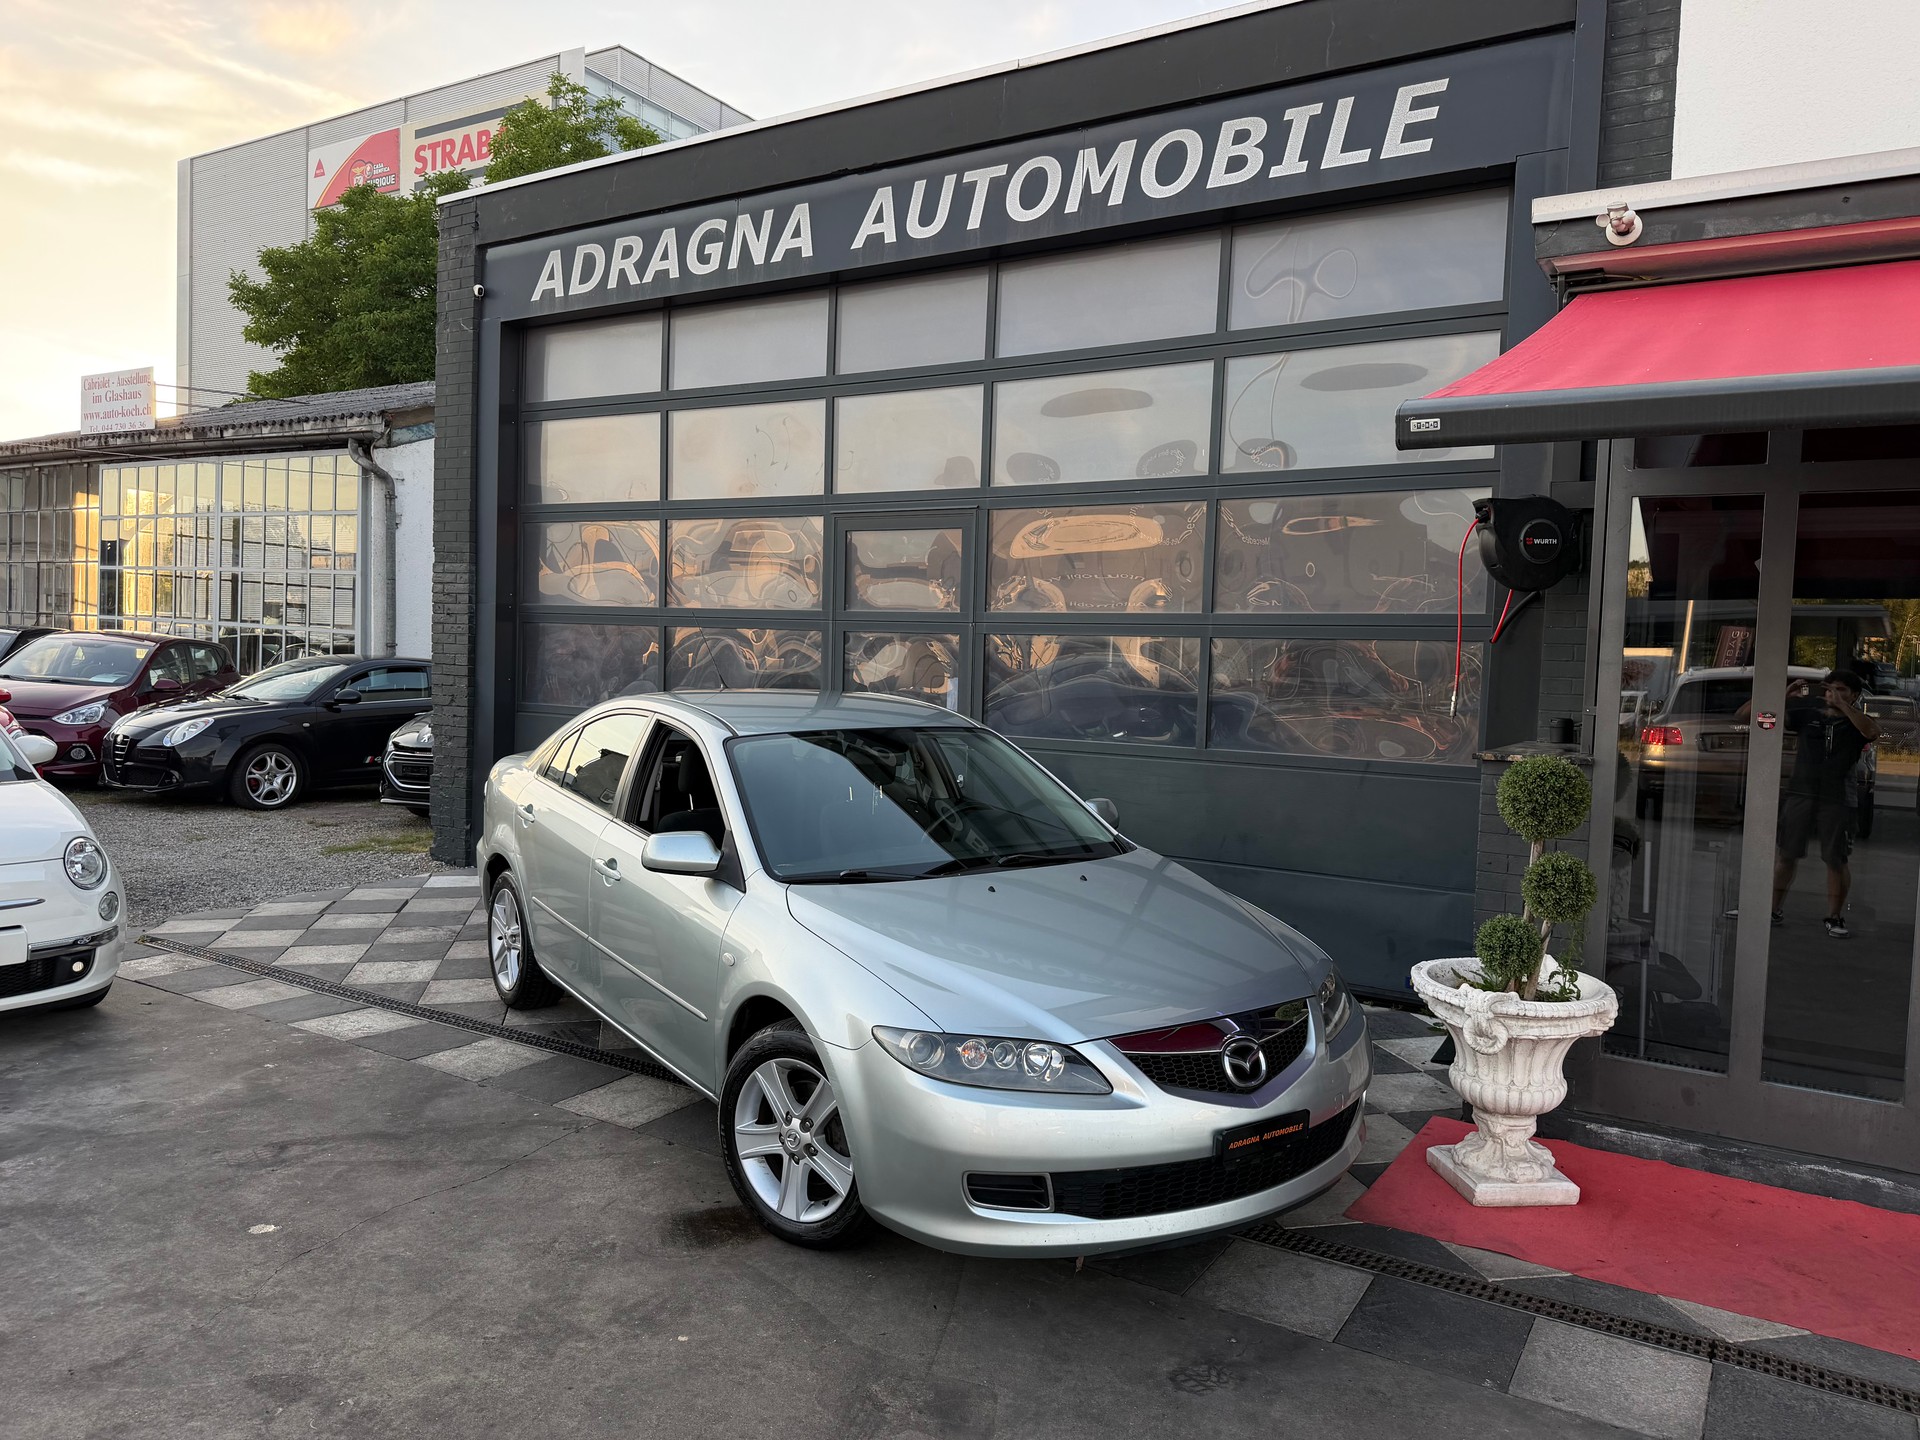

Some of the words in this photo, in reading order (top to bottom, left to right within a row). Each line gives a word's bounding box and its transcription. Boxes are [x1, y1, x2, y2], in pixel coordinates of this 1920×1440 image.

[413, 126, 508, 176] STRAB
[529, 202, 815, 302] ADRAGNA
[849, 77, 1450, 250] AUTOMOBILE
[83, 376, 110, 391] Cabriolet
[116, 372, 152, 387] Ausstellung
[92, 392, 102, 404] im
[104, 388, 142, 403] Glashaus
[83, 403, 152, 422] www.auto-koch.ch
[101, 424, 113, 432] 044
[1228, 1134, 1261, 1150] ADRAGNA
[1262, 1122, 1304, 1140] AUTOMOBILE
